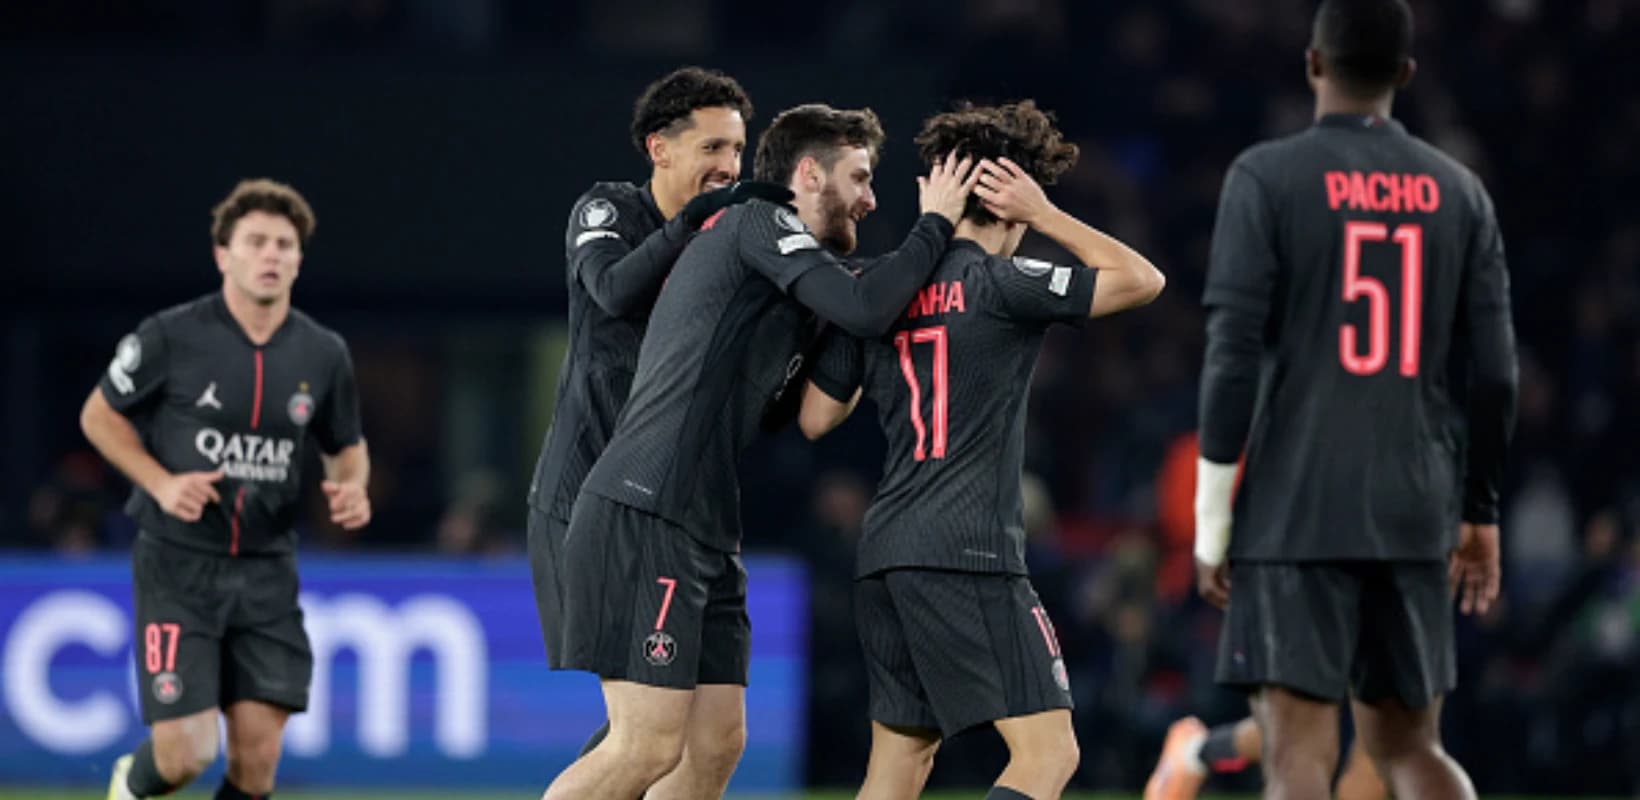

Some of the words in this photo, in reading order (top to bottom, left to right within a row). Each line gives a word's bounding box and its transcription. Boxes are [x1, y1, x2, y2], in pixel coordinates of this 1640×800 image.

[1324, 170, 1441, 213] PACHO
[908, 280, 966, 319] NHA
[1338, 219, 1424, 378] 51
[894, 325, 948, 462] 17
[195, 427, 294, 465] QATAR
[654, 576, 678, 630] 7
[2, 589, 489, 758] cm
[144, 622, 181, 674] 87
